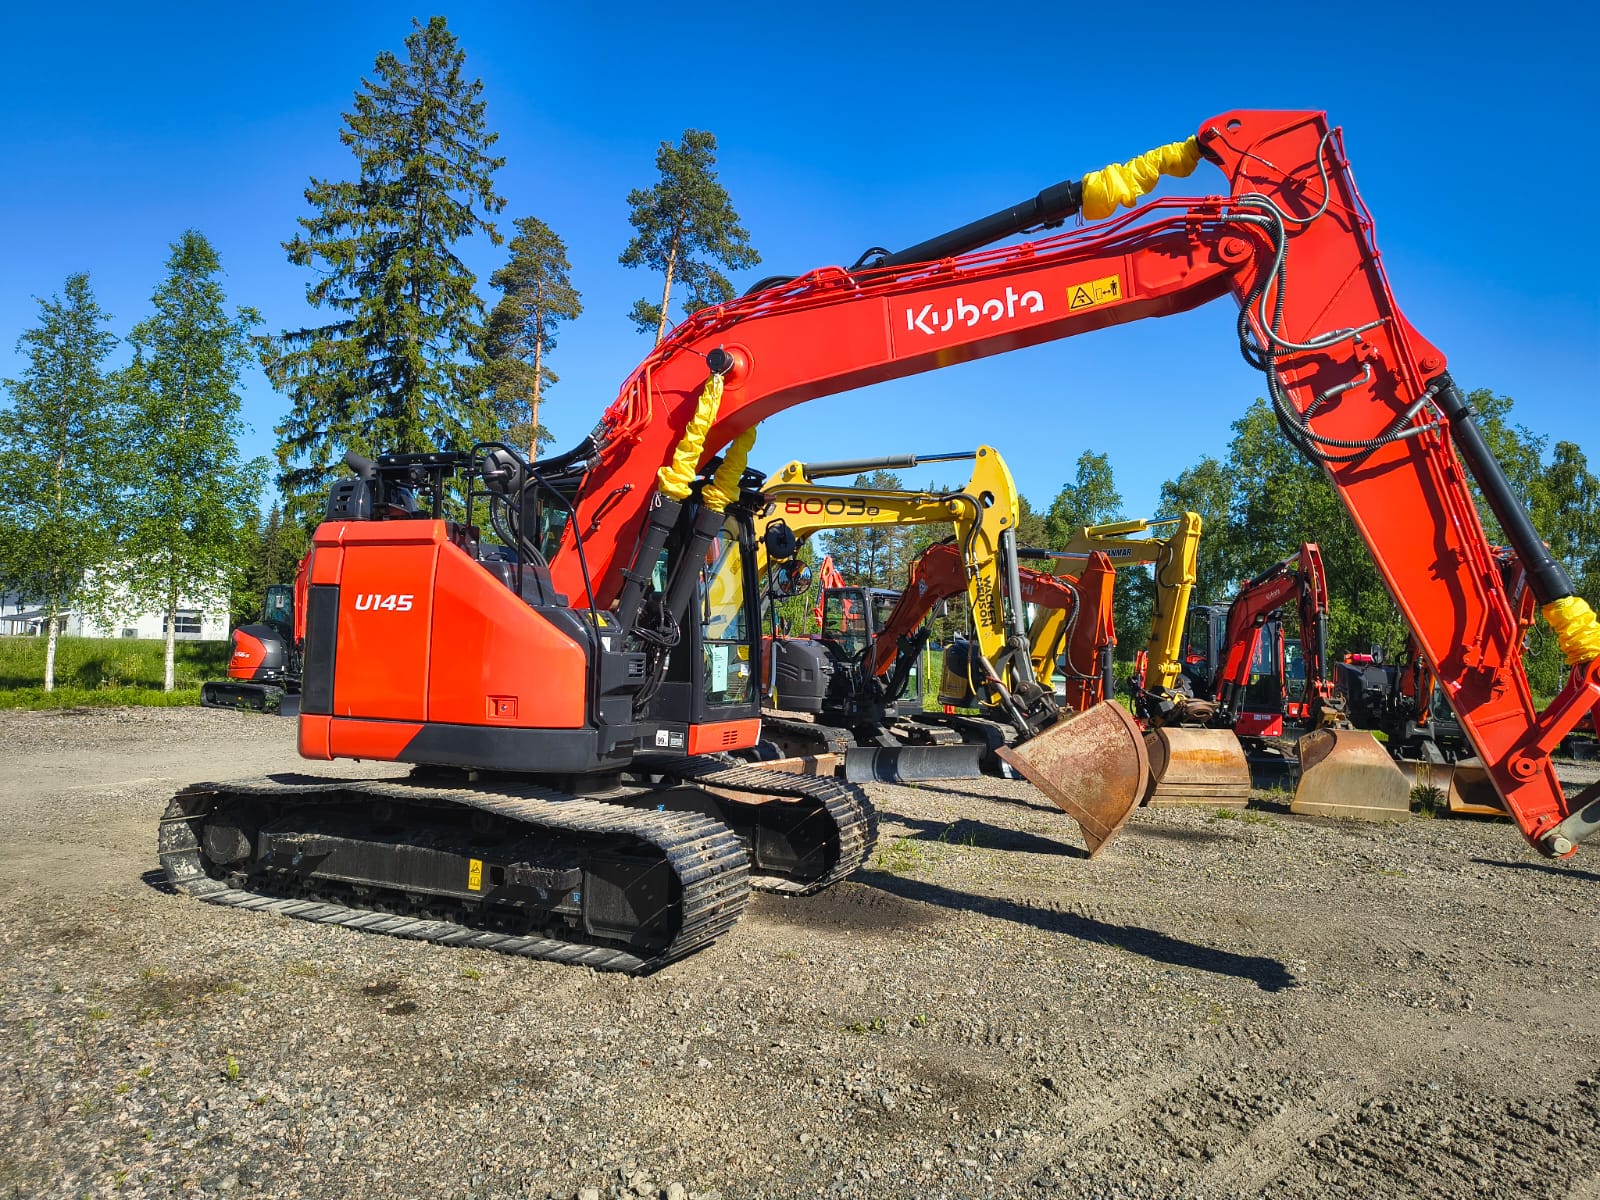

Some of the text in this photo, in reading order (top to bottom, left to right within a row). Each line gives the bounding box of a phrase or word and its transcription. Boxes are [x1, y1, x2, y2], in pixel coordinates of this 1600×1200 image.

[906, 286, 1044, 335] Kubota
[355, 594, 414, 612] U145
[983, 575, 997, 625] WACKER
